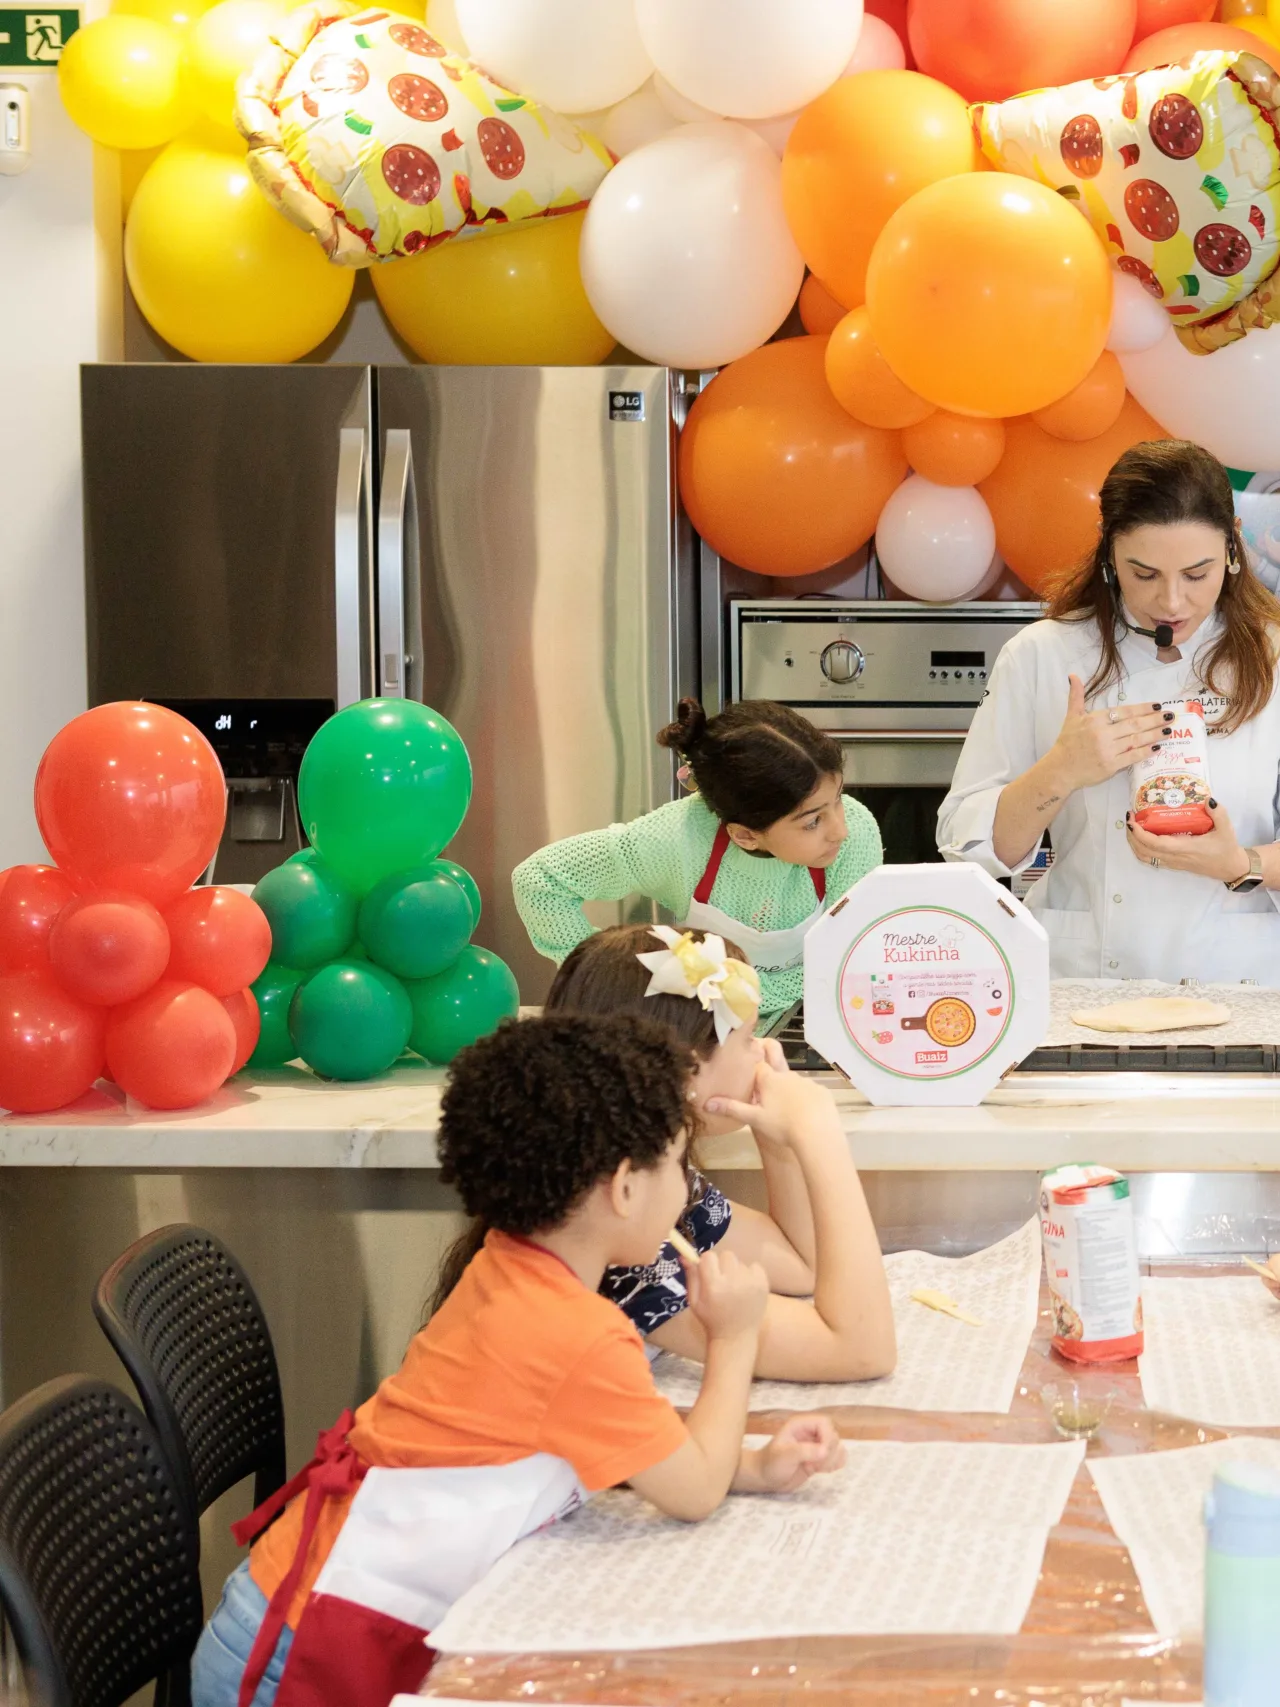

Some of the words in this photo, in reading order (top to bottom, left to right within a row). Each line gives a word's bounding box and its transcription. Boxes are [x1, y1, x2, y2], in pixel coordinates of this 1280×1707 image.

[626, 397, 640, 406] LG
[883, 933, 937, 946] Mestre
[884, 945, 960, 963] Kukinha
[917, 1053, 948, 1062] Buaiz
